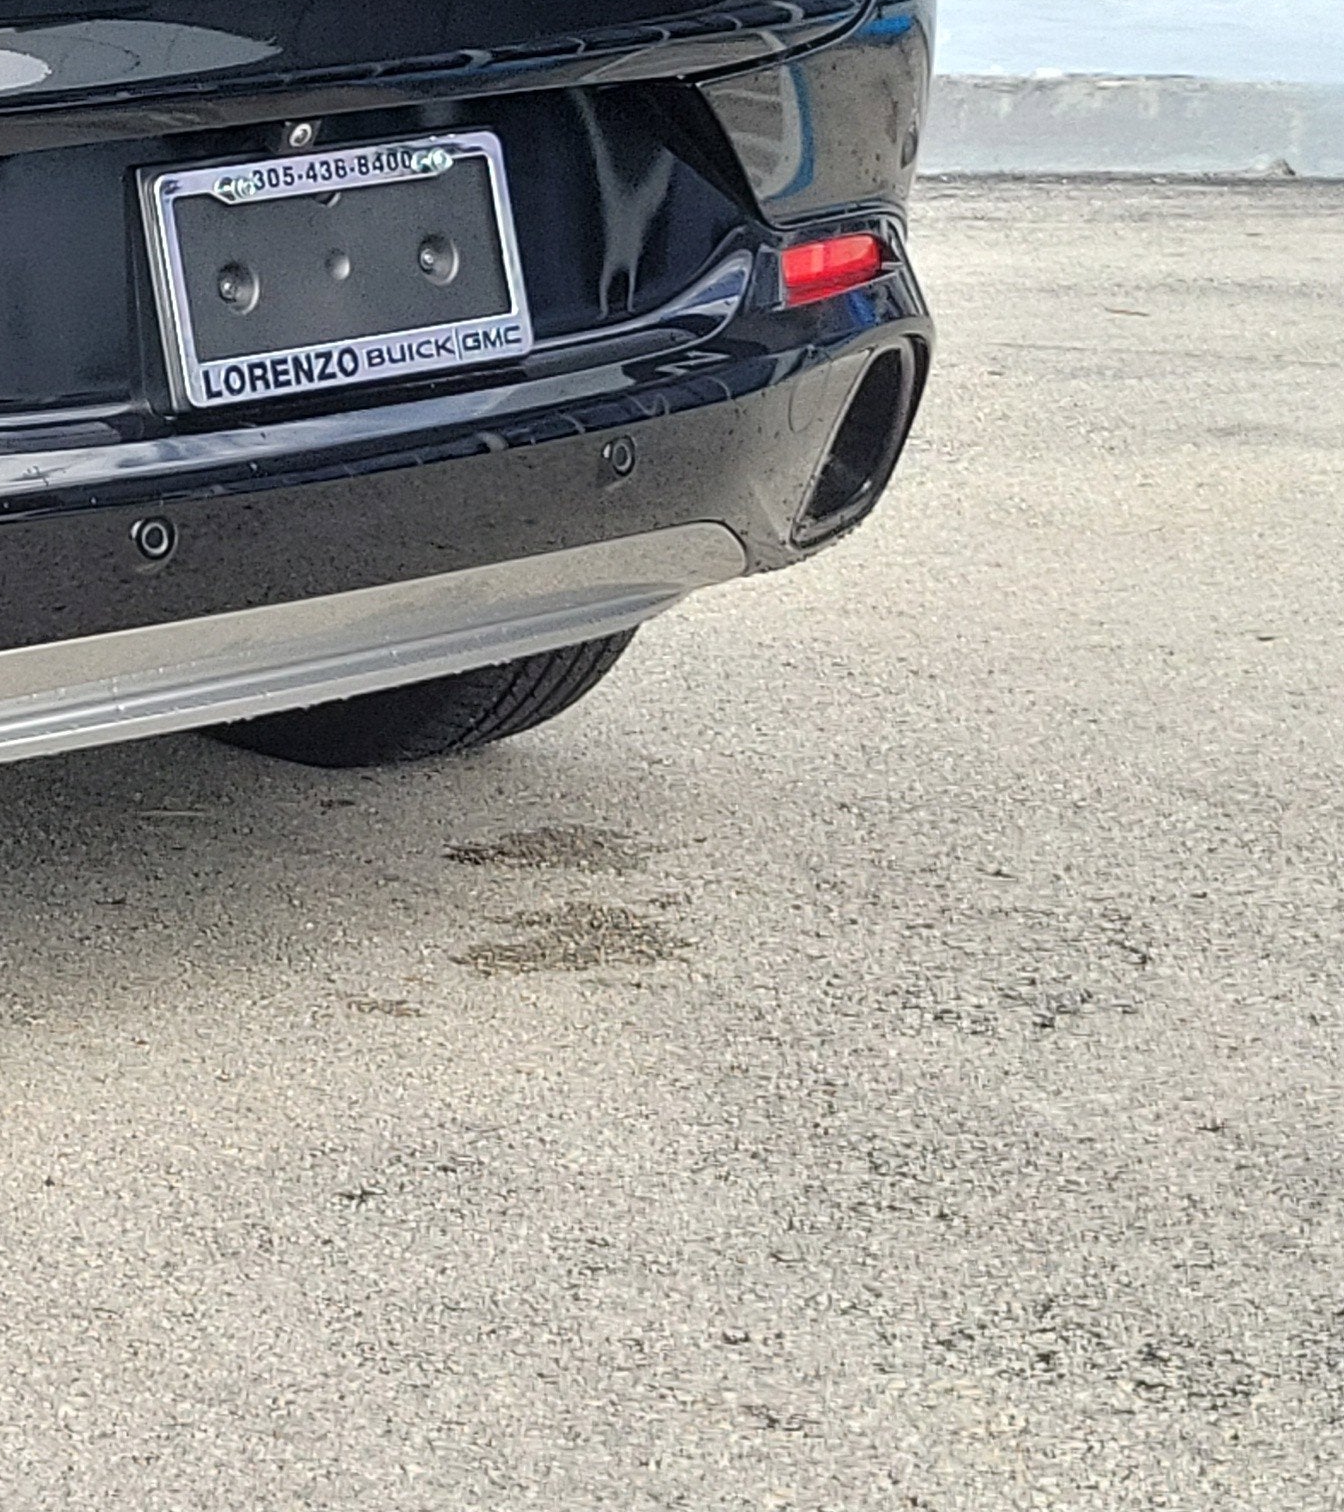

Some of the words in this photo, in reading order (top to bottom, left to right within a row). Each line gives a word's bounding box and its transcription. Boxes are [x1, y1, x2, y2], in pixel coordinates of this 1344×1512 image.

[203, 348, 360, 401] LORENZO
[366, 339, 455, 369] BUICK
[461, 325, 524, 353] GMC
